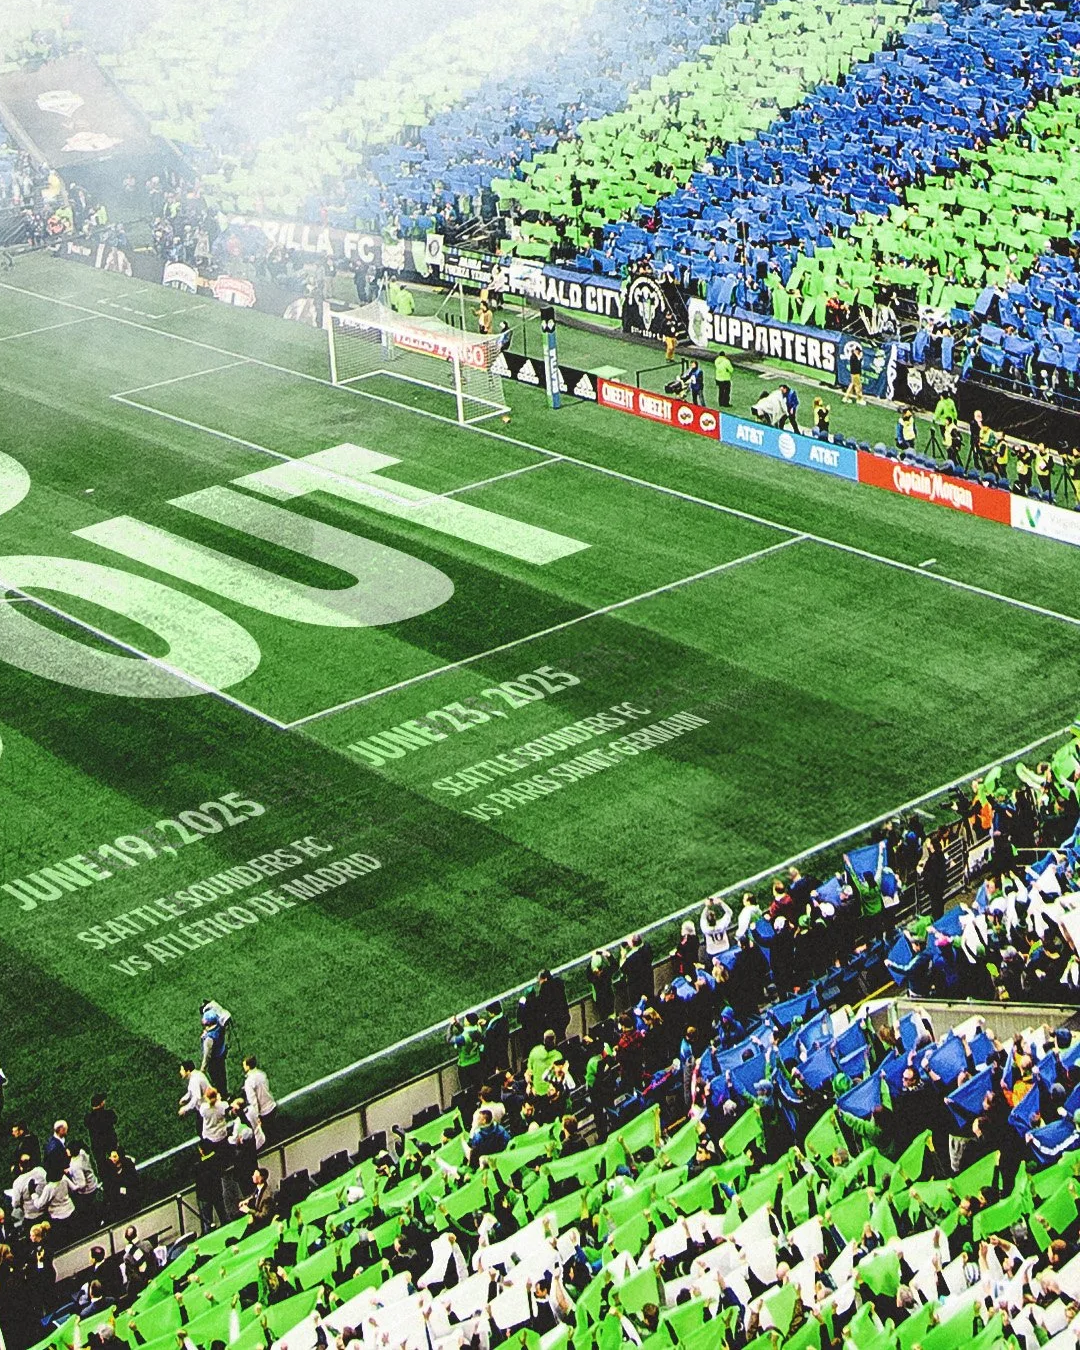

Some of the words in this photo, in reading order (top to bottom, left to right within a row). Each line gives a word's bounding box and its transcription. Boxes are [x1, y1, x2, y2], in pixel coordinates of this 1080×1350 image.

[343, 231, 375, 263] FC
[585, 285, 623, 318] CITY
[703, 310, 836, 372] SUPPORTERS
[735, 424, 764, 446] AT&T
[809, 445, 840, 467] AT&T
[892, 465, 931, 496] Captain
[929, 473, 974, 512] Morgan
